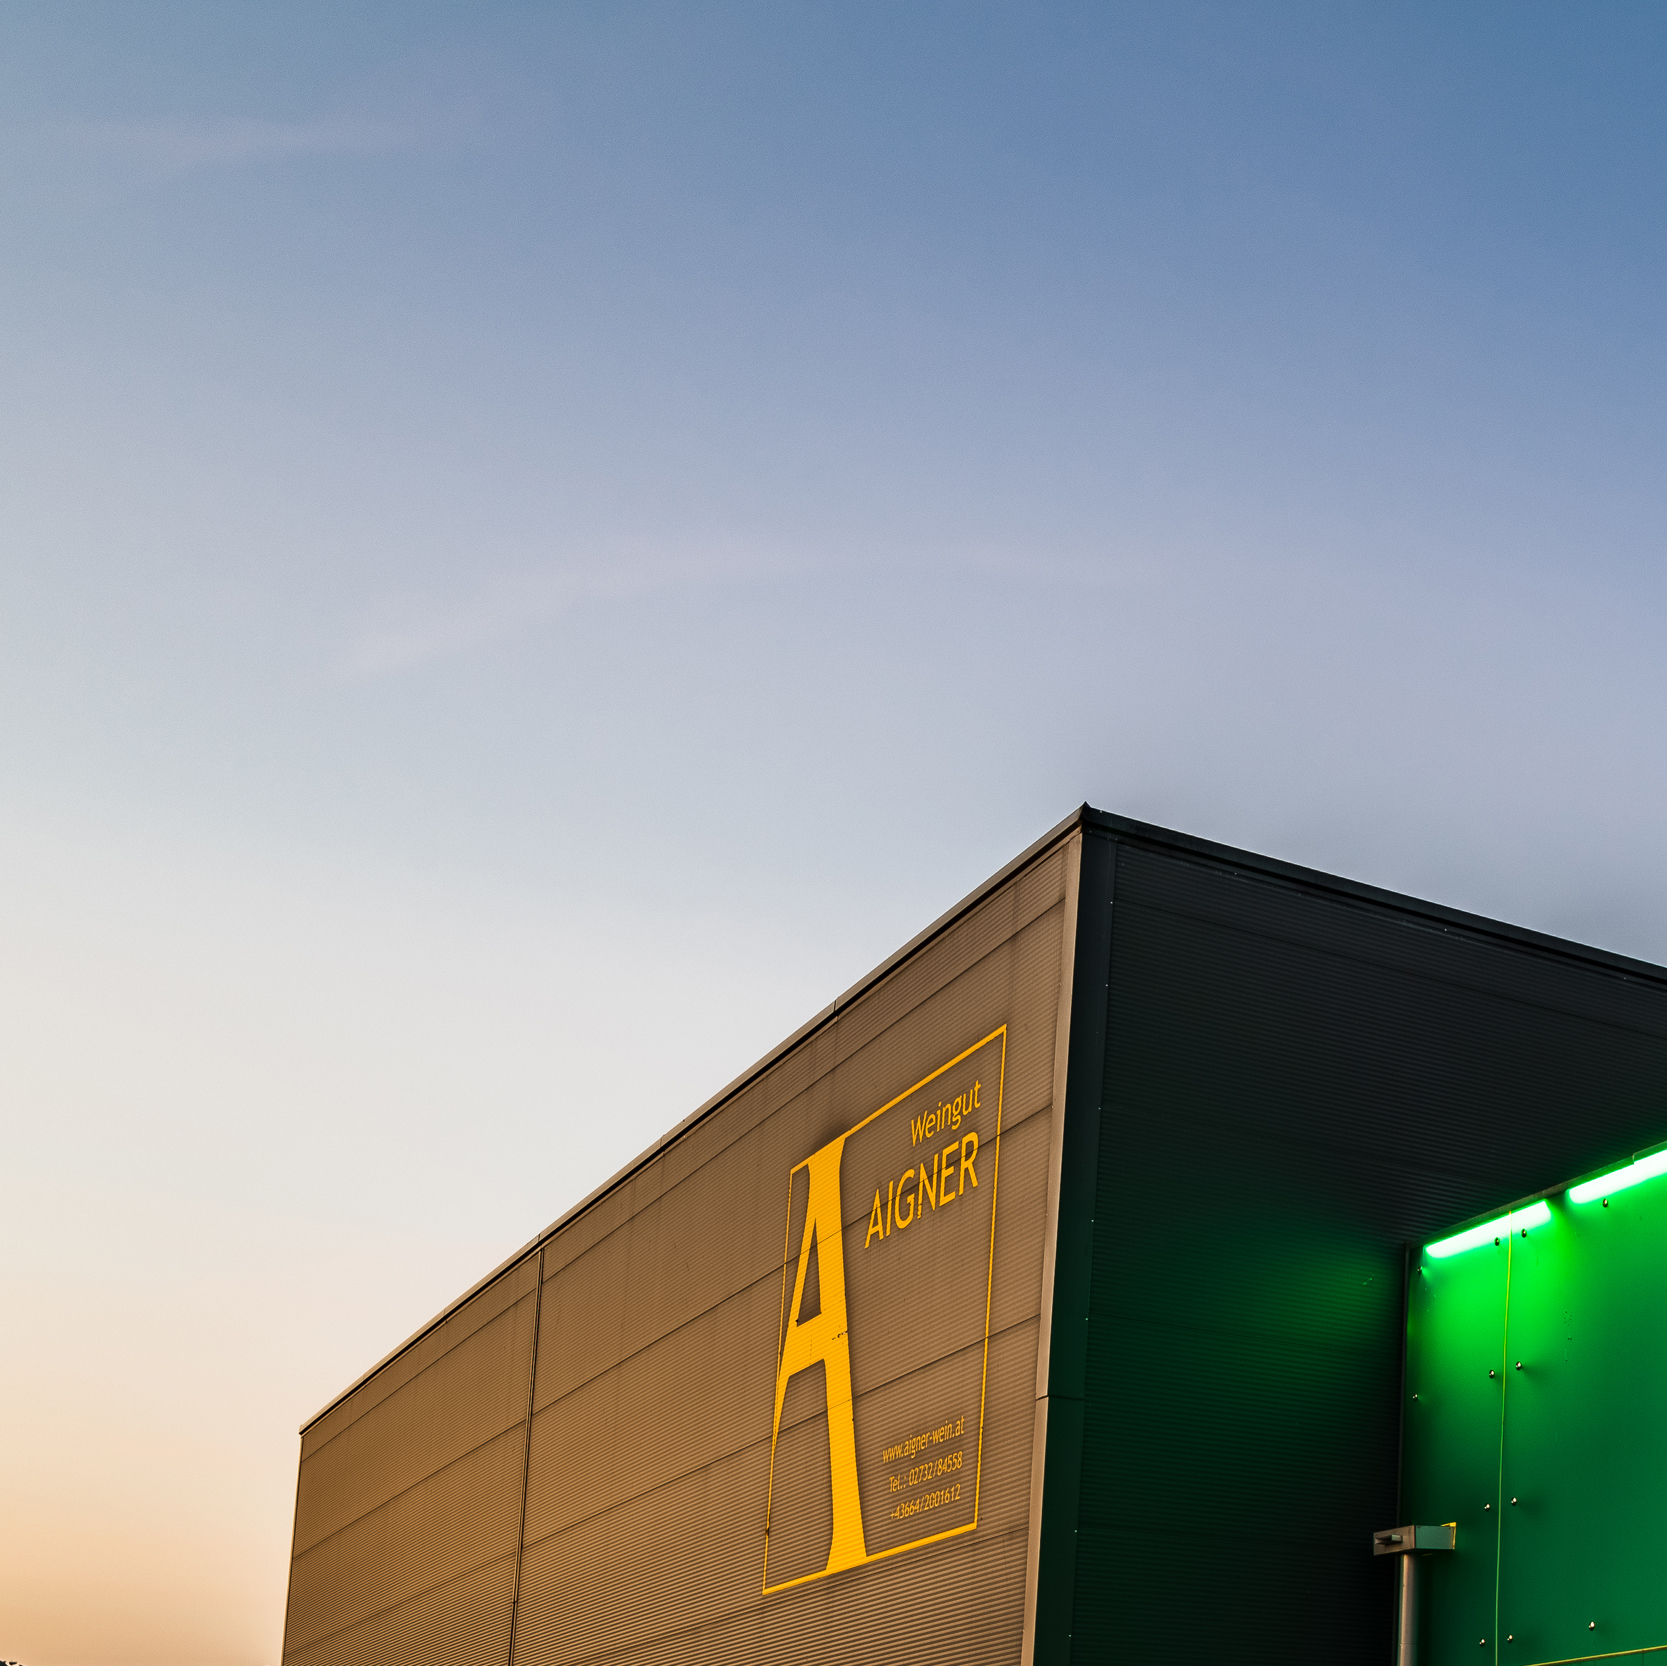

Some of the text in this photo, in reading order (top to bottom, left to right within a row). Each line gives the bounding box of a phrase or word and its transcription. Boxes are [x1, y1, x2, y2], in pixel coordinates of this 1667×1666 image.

[911, 1080, 981, 1147] Weingut
[864, 1131, 979, 1249] AIGNER
[882, 1415, 965, 1464] www.aigner-wein.at
[889, 1450, 963, 1493] Tel.: 02732/84558
[890, 1483, 961, 1520] +43664/2001612
